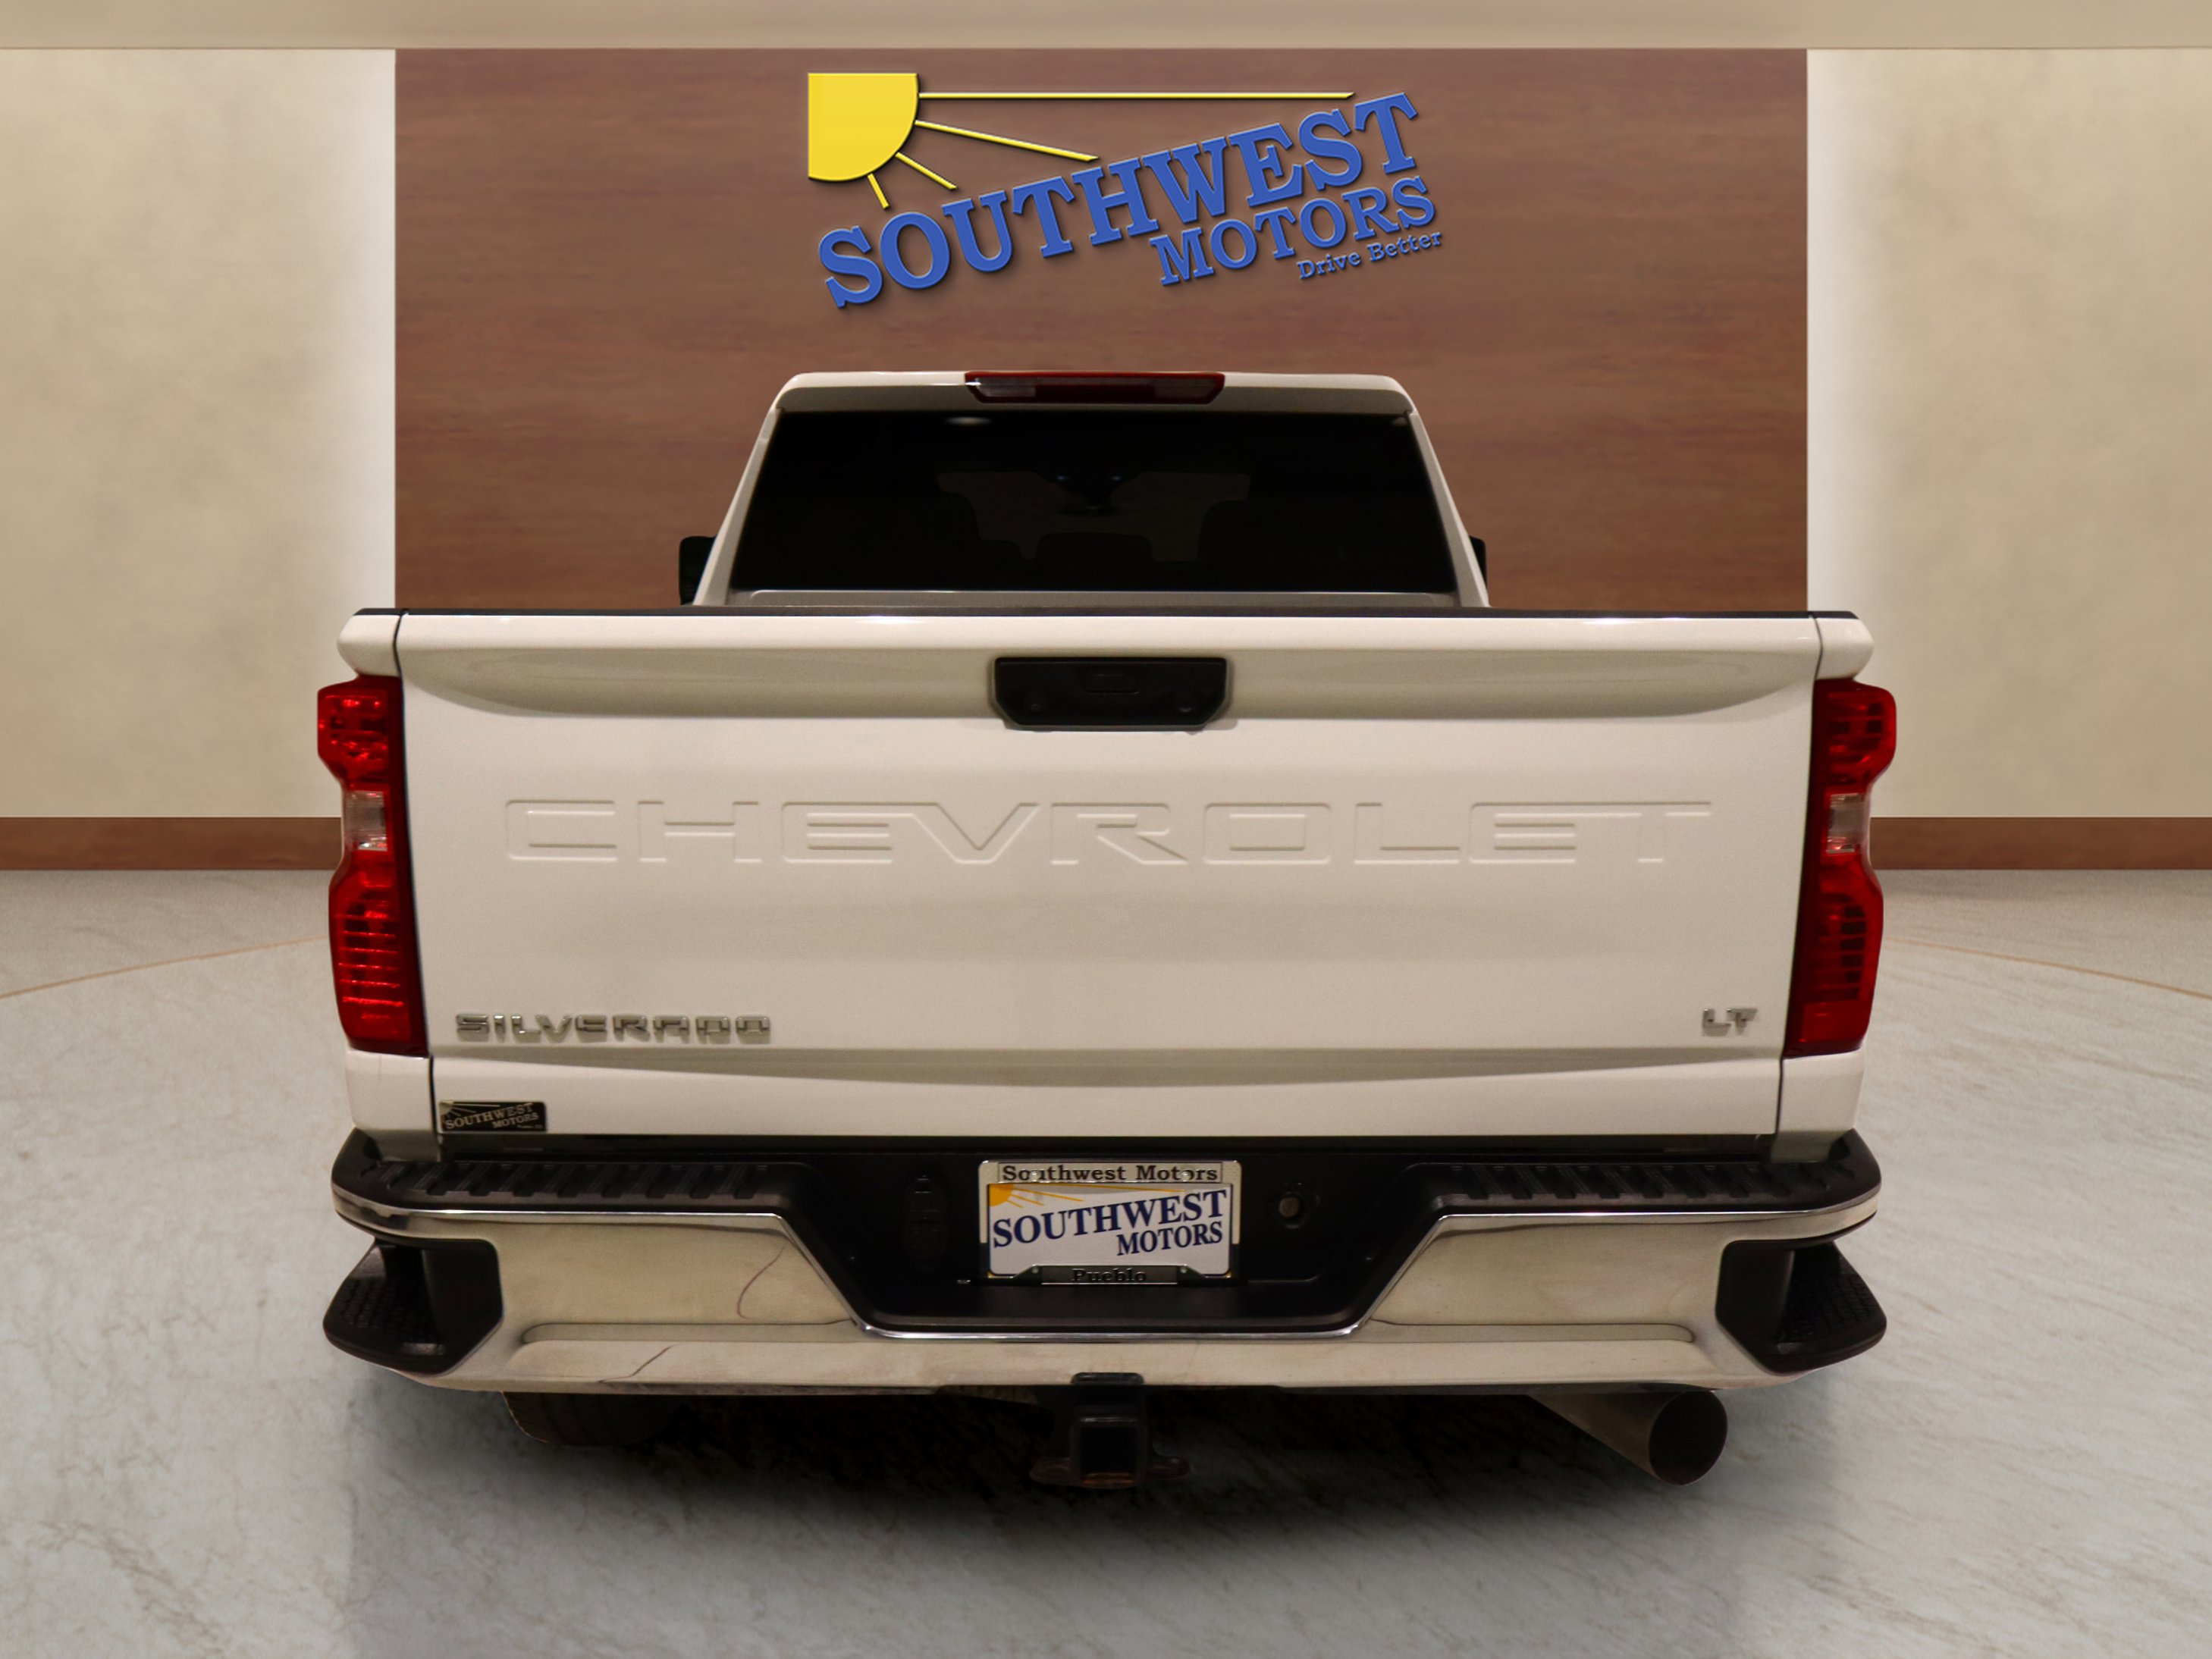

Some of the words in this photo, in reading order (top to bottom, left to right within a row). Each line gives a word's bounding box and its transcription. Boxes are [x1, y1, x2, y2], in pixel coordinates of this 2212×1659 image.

[818, 92, 1418, 308] SOUTHWEST
[1150, 176, 1436, 285] MOTORS
[1297, 252, 1362, 280] Drive
[1366, 231, 1442, 262] Better
[506, 800, 1712, 864] CHEVROLET
[456, 1014, 770, 1041] SILVERADO
[1702, 1008, 1759, 1036] LT
[445, 1102, 534, 1129] SOUTHWEST
[492, 1112, 539, 1128] MOTORS
[993, 1190, 1227, 1248] SOUTHWEST
[1116, 1221, 1223, 1256] MOTORS
[1071, 1269, 1147, 1283] Pueblo
